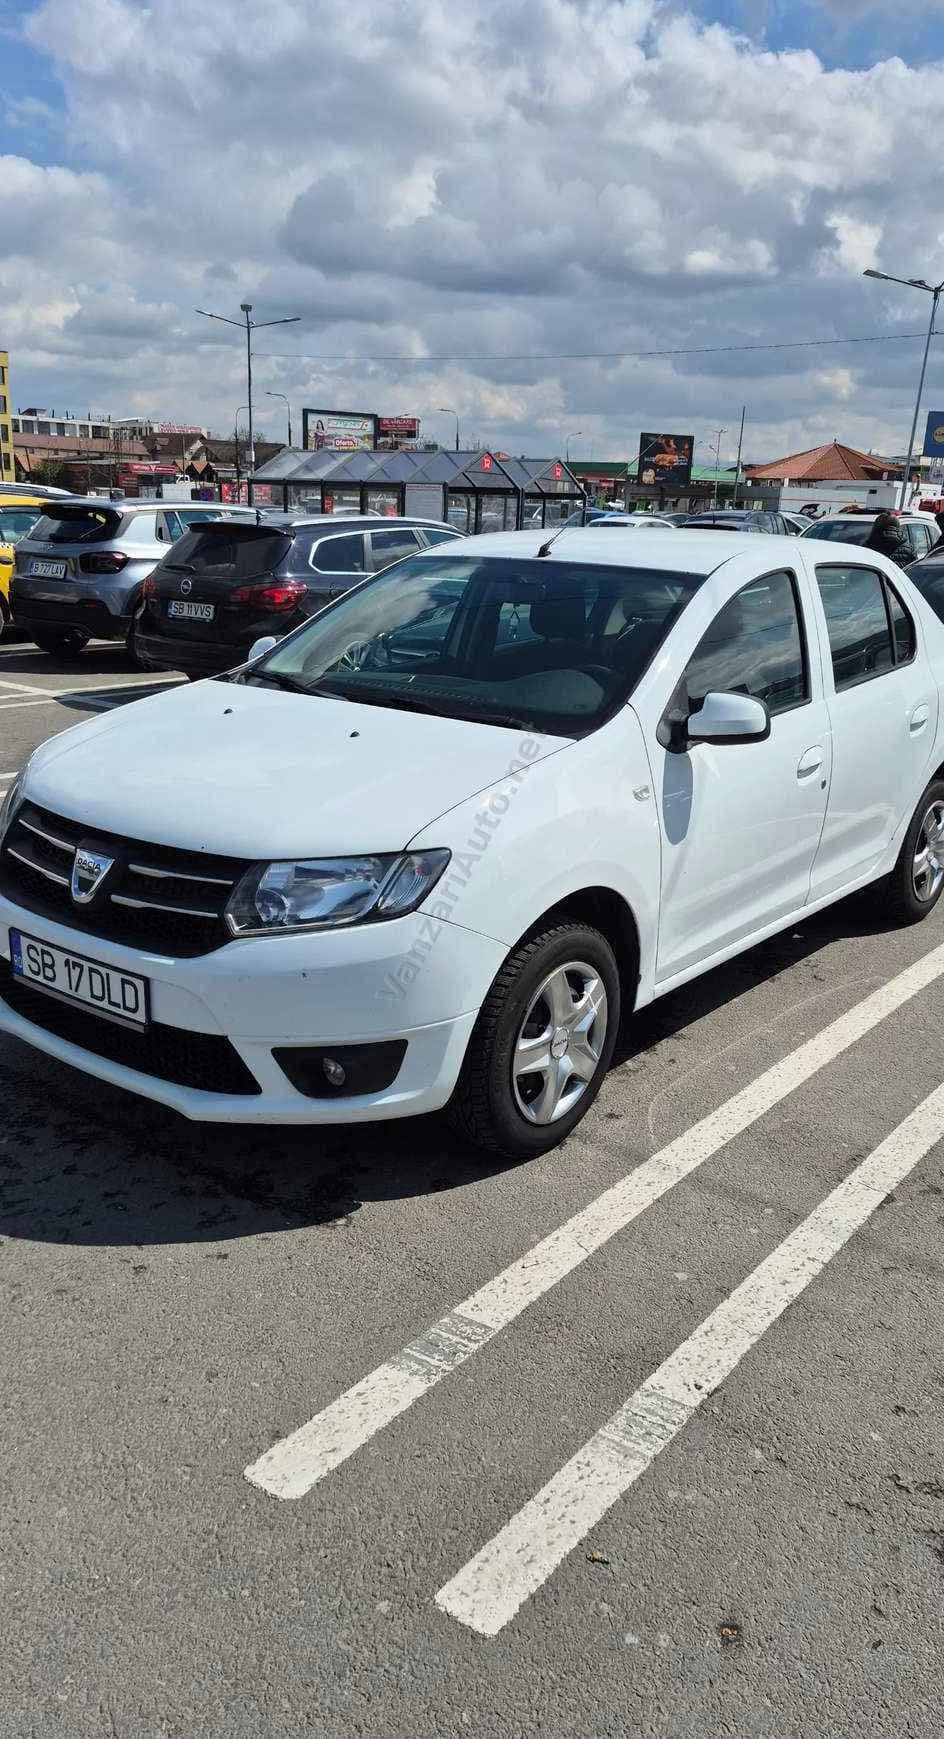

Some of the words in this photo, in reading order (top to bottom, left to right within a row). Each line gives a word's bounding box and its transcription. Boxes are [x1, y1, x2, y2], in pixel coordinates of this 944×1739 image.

[174, 602, 184, 614] SB
[78, 858, 101, 871] DACIA
[26, 944, 57, 983] SB
